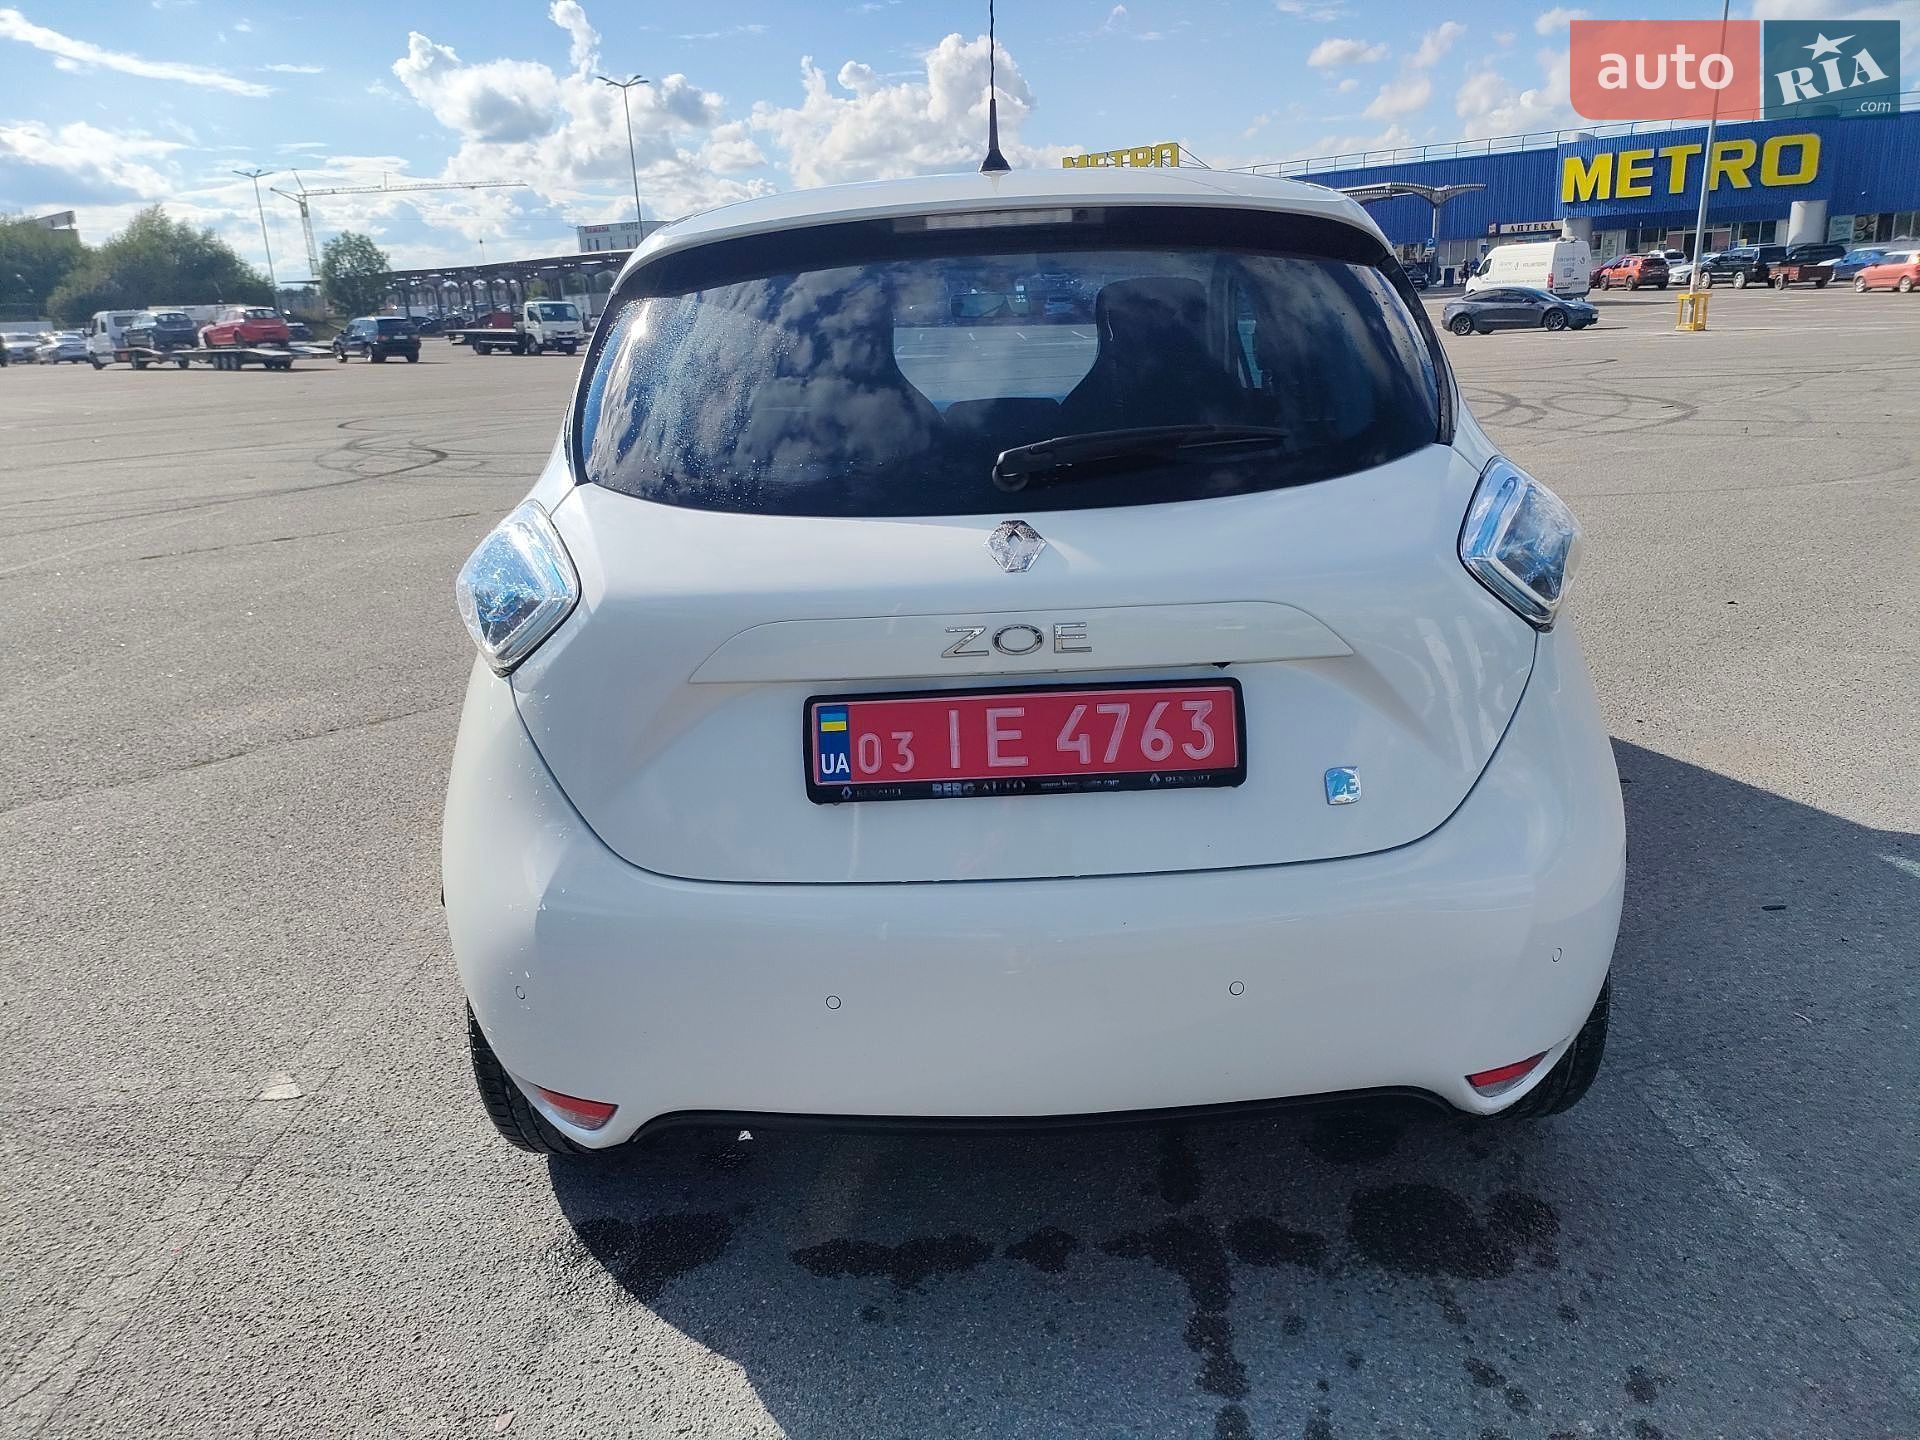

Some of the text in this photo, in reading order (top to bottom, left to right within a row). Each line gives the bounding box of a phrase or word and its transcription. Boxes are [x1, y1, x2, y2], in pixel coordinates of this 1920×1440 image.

[1561, 133, 1821, 203] METRO
[1509, 222, 1555, 232] АПТЕКА
[941, 622, 1092, 658] ZOE
[858, 700, 1215, 774] 03 IE 4763
[821, 752, 849, 774] UA
